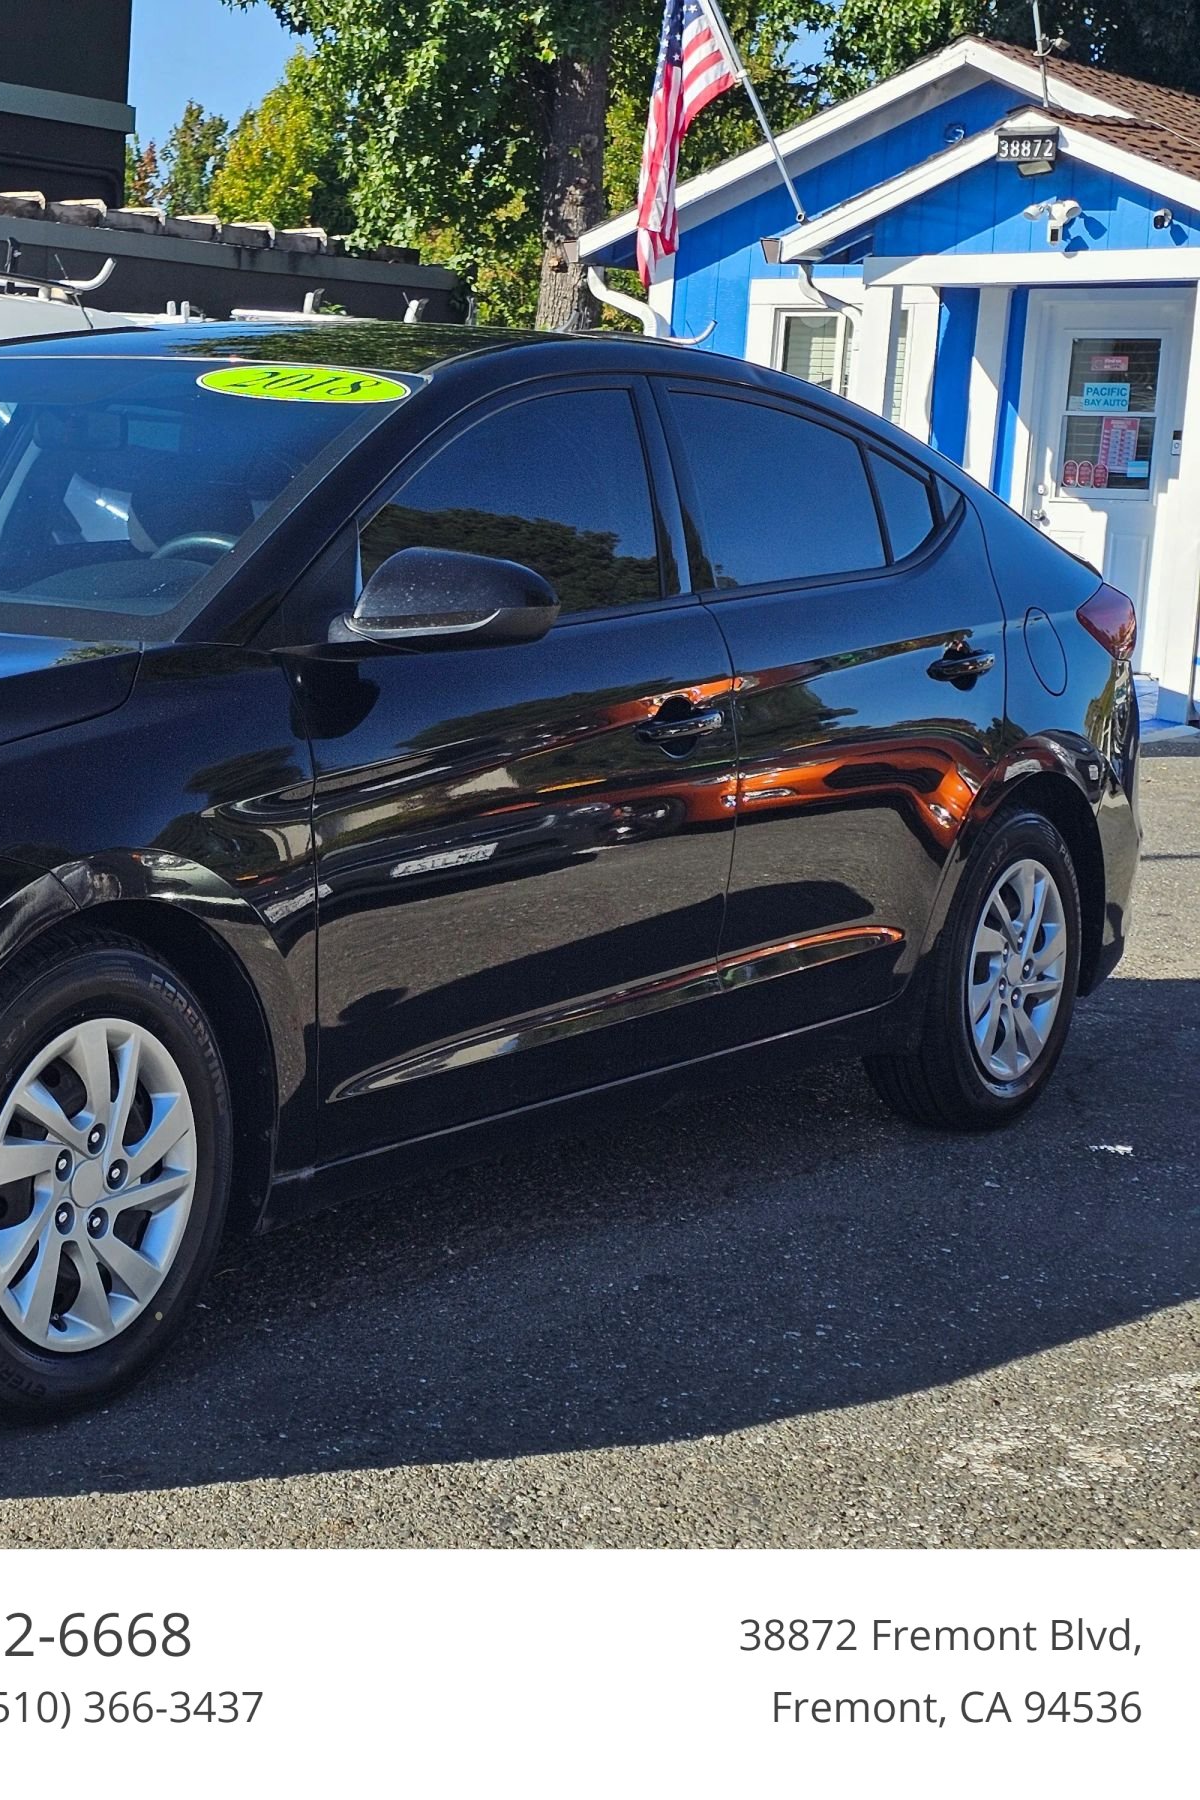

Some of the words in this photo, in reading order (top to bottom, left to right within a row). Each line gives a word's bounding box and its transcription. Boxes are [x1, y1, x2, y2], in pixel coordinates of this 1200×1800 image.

[999, 139, 1054, 158] 38872
[224, 371, 381, 396] 2018
[1086, 387, 1128, 397] PACIFIC
[1084, 398, 1101, 407] BAY
[1103, 399, 1128, 407] AUTO
